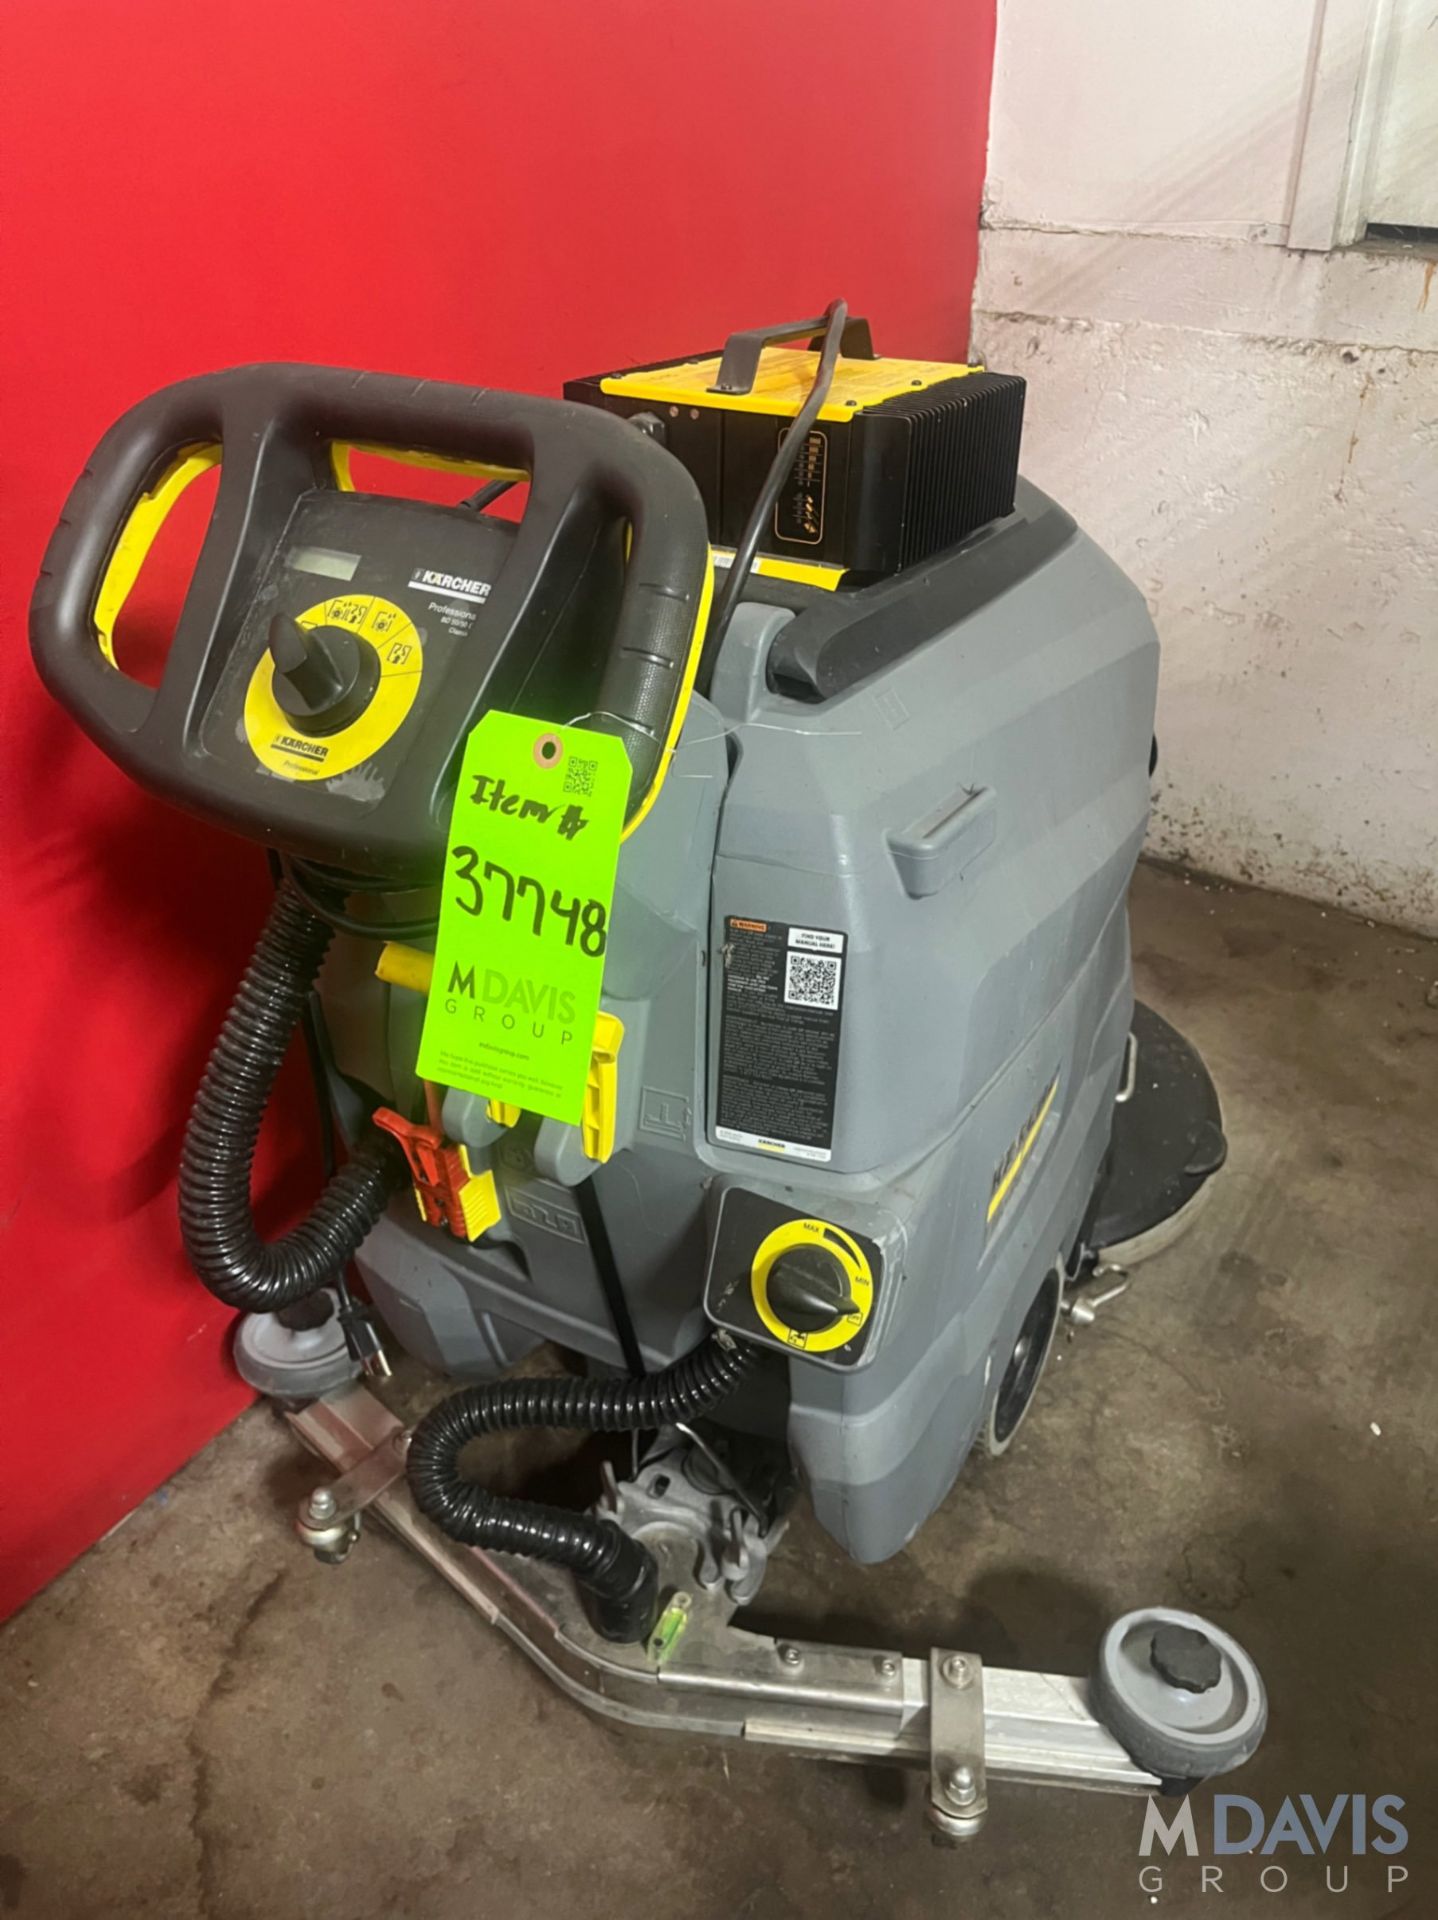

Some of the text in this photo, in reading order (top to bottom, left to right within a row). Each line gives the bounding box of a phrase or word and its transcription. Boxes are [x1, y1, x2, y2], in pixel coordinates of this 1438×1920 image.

[470, 774, 559, 824] Item
[452, 845, 607, 957] 37748
[447, 961, 576, 1025] M DAVIS
[445, 1000, 573, 1046] GROUP
[803, 1222, 820, 1234] MAX
[855, 1276, 870, 1287] MIN
